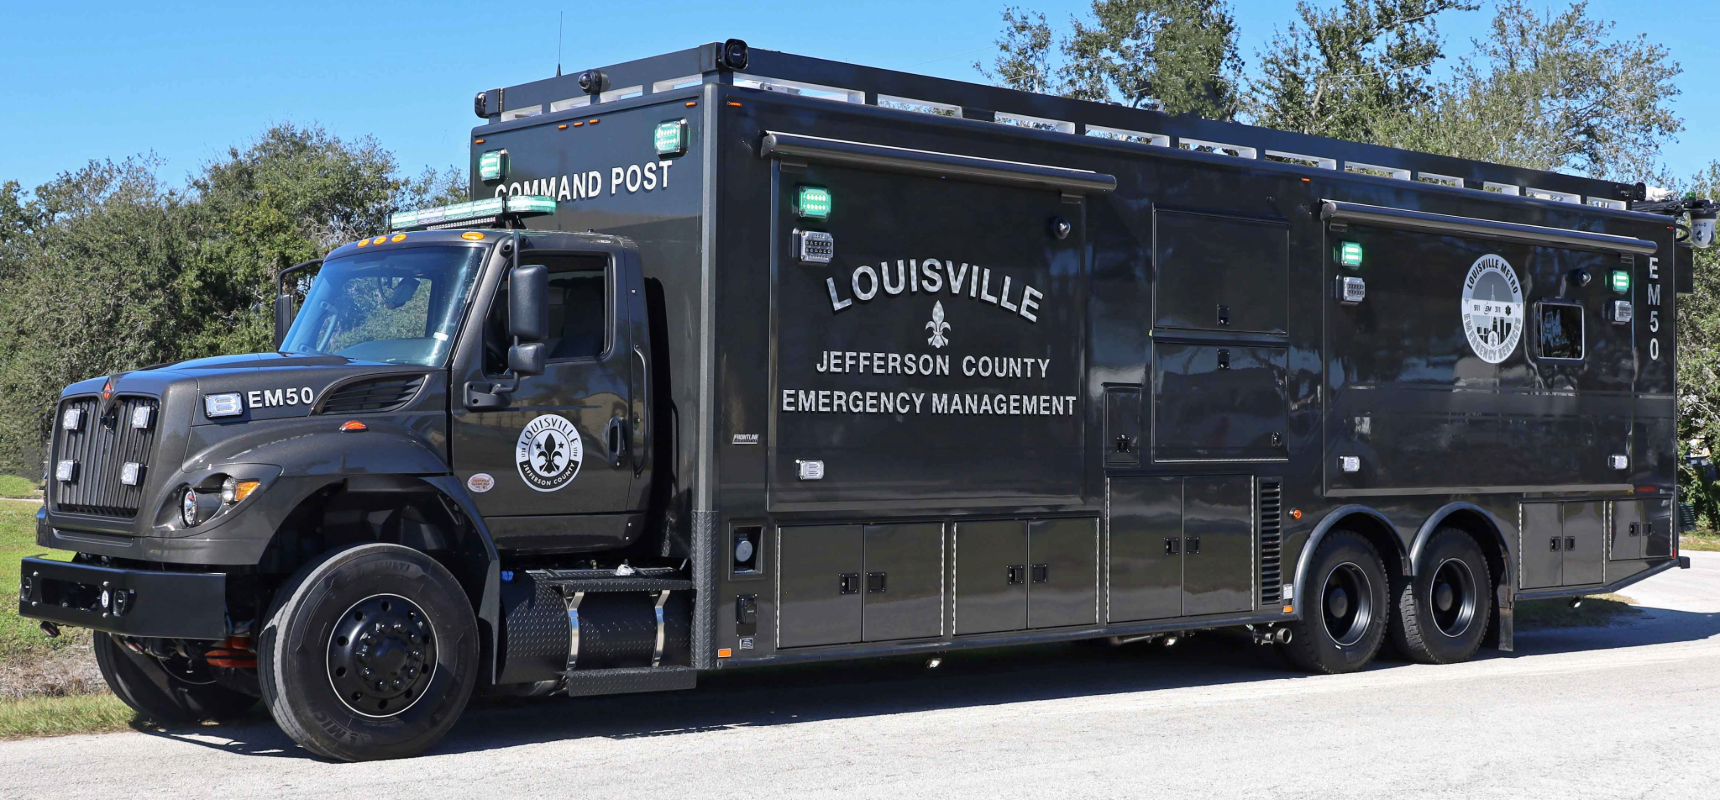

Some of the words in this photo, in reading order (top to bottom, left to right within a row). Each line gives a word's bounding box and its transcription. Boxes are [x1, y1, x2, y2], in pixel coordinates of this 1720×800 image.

[611, 160, 673, 194] POST
[826, 258, 1044, 323] LOUISVILLE
[1466, 258, 1499, 289] LOUISVILLE
[1500, 262, 1519, 294] METRO
[1647, 256, 1661, 360] EM50
[1459, 313, 1498, 361] EMERGENCY
[1498, 317, 1522, 360] SERVICES
[816, 350, 950, 376] JEFFERSON
[962, 355, 1051, 378] COUNTY
[247, 386, 314, 408] EM50
[782, 389, 926, 414] EMERGENCY
[931, 393, 1078, 416] MANAGEMENT
[520, 416, 580, 446] LOUISVILLE
[523, 464, 552, 486] JEFFERSON
[553, 462, 576, 485] COUNTY
